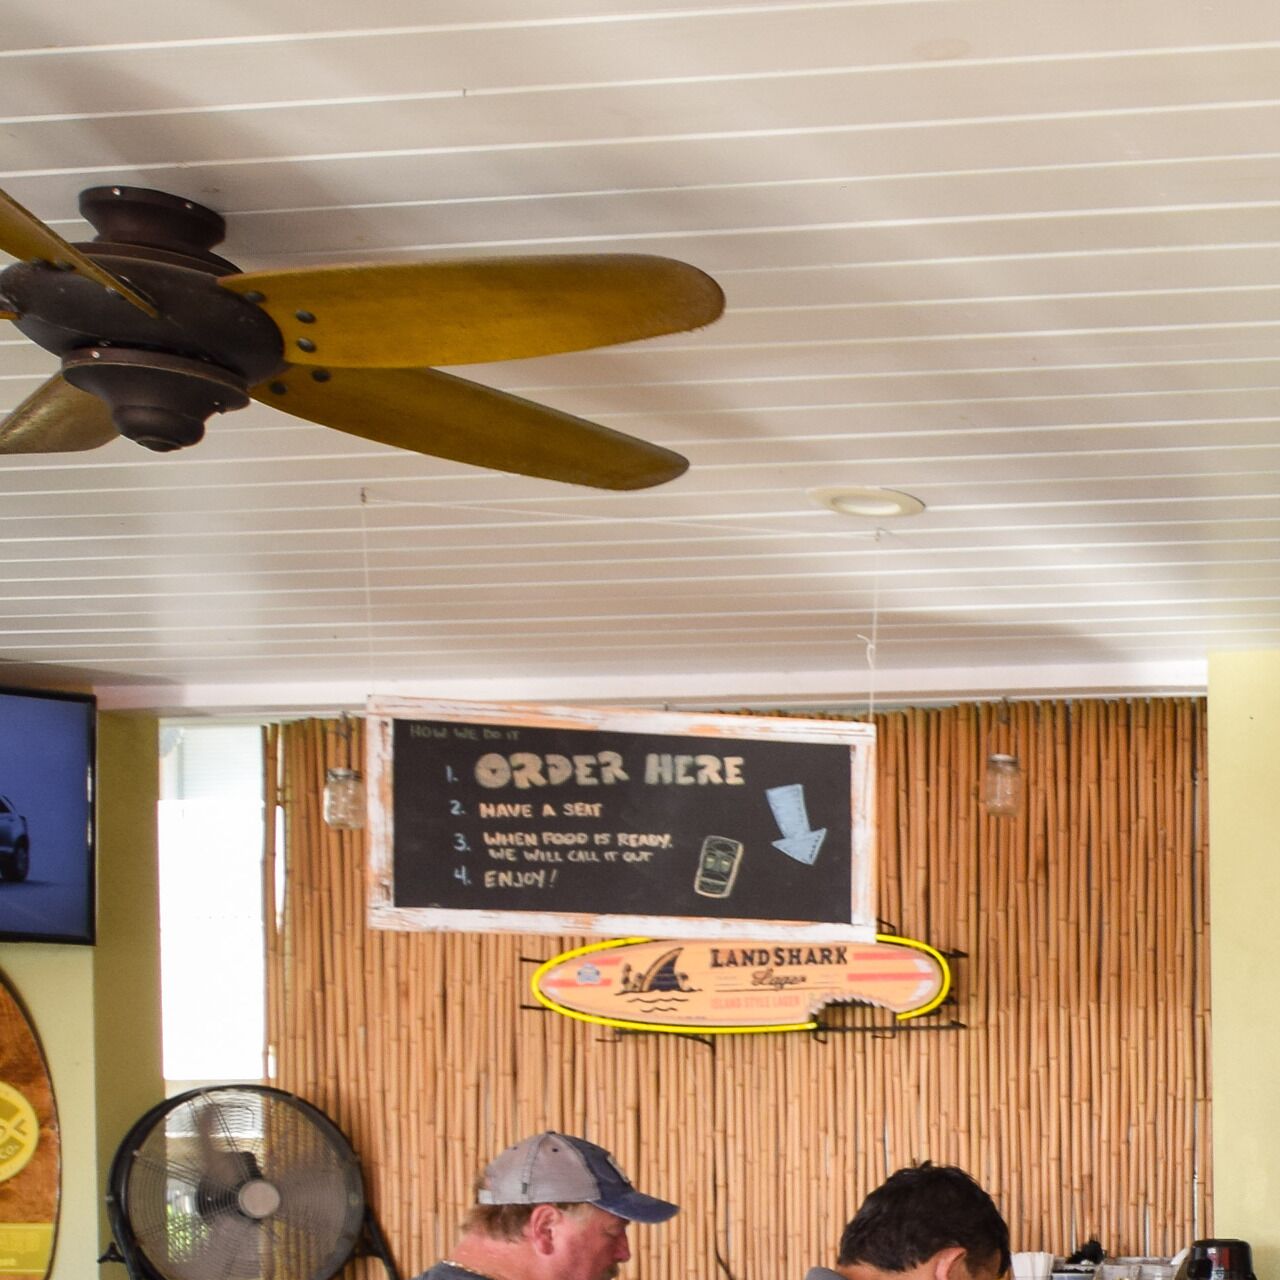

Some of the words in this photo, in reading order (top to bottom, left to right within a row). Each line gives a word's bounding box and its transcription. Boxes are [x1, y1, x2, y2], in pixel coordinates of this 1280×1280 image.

[410, 723, 447, 739] HOW
[453, 728, 479, 741] WE
[474, 750, 630, 790] ORDER
[644, 753, 745, 786] HERE
[479, 802, 533, 819] HAVE
[542, 803, 557, 817] A
[563, 803, 602, 818] SEAT
[483, 831, 538, 846] WHEN
[542, 831, 589, 846] FOOD
[594, 834, 610, 846] IS
[489, 848, 517, 862] WE
[523, 849, 562, 863] WILL
[567, 849, 599, 863] CALL
[604, 851, 616, 862] IT
[624, 850, 653, 863] OUT
[484, 869, 558, 889] ENJOY!
[752, 968, 807, 991] Lager
